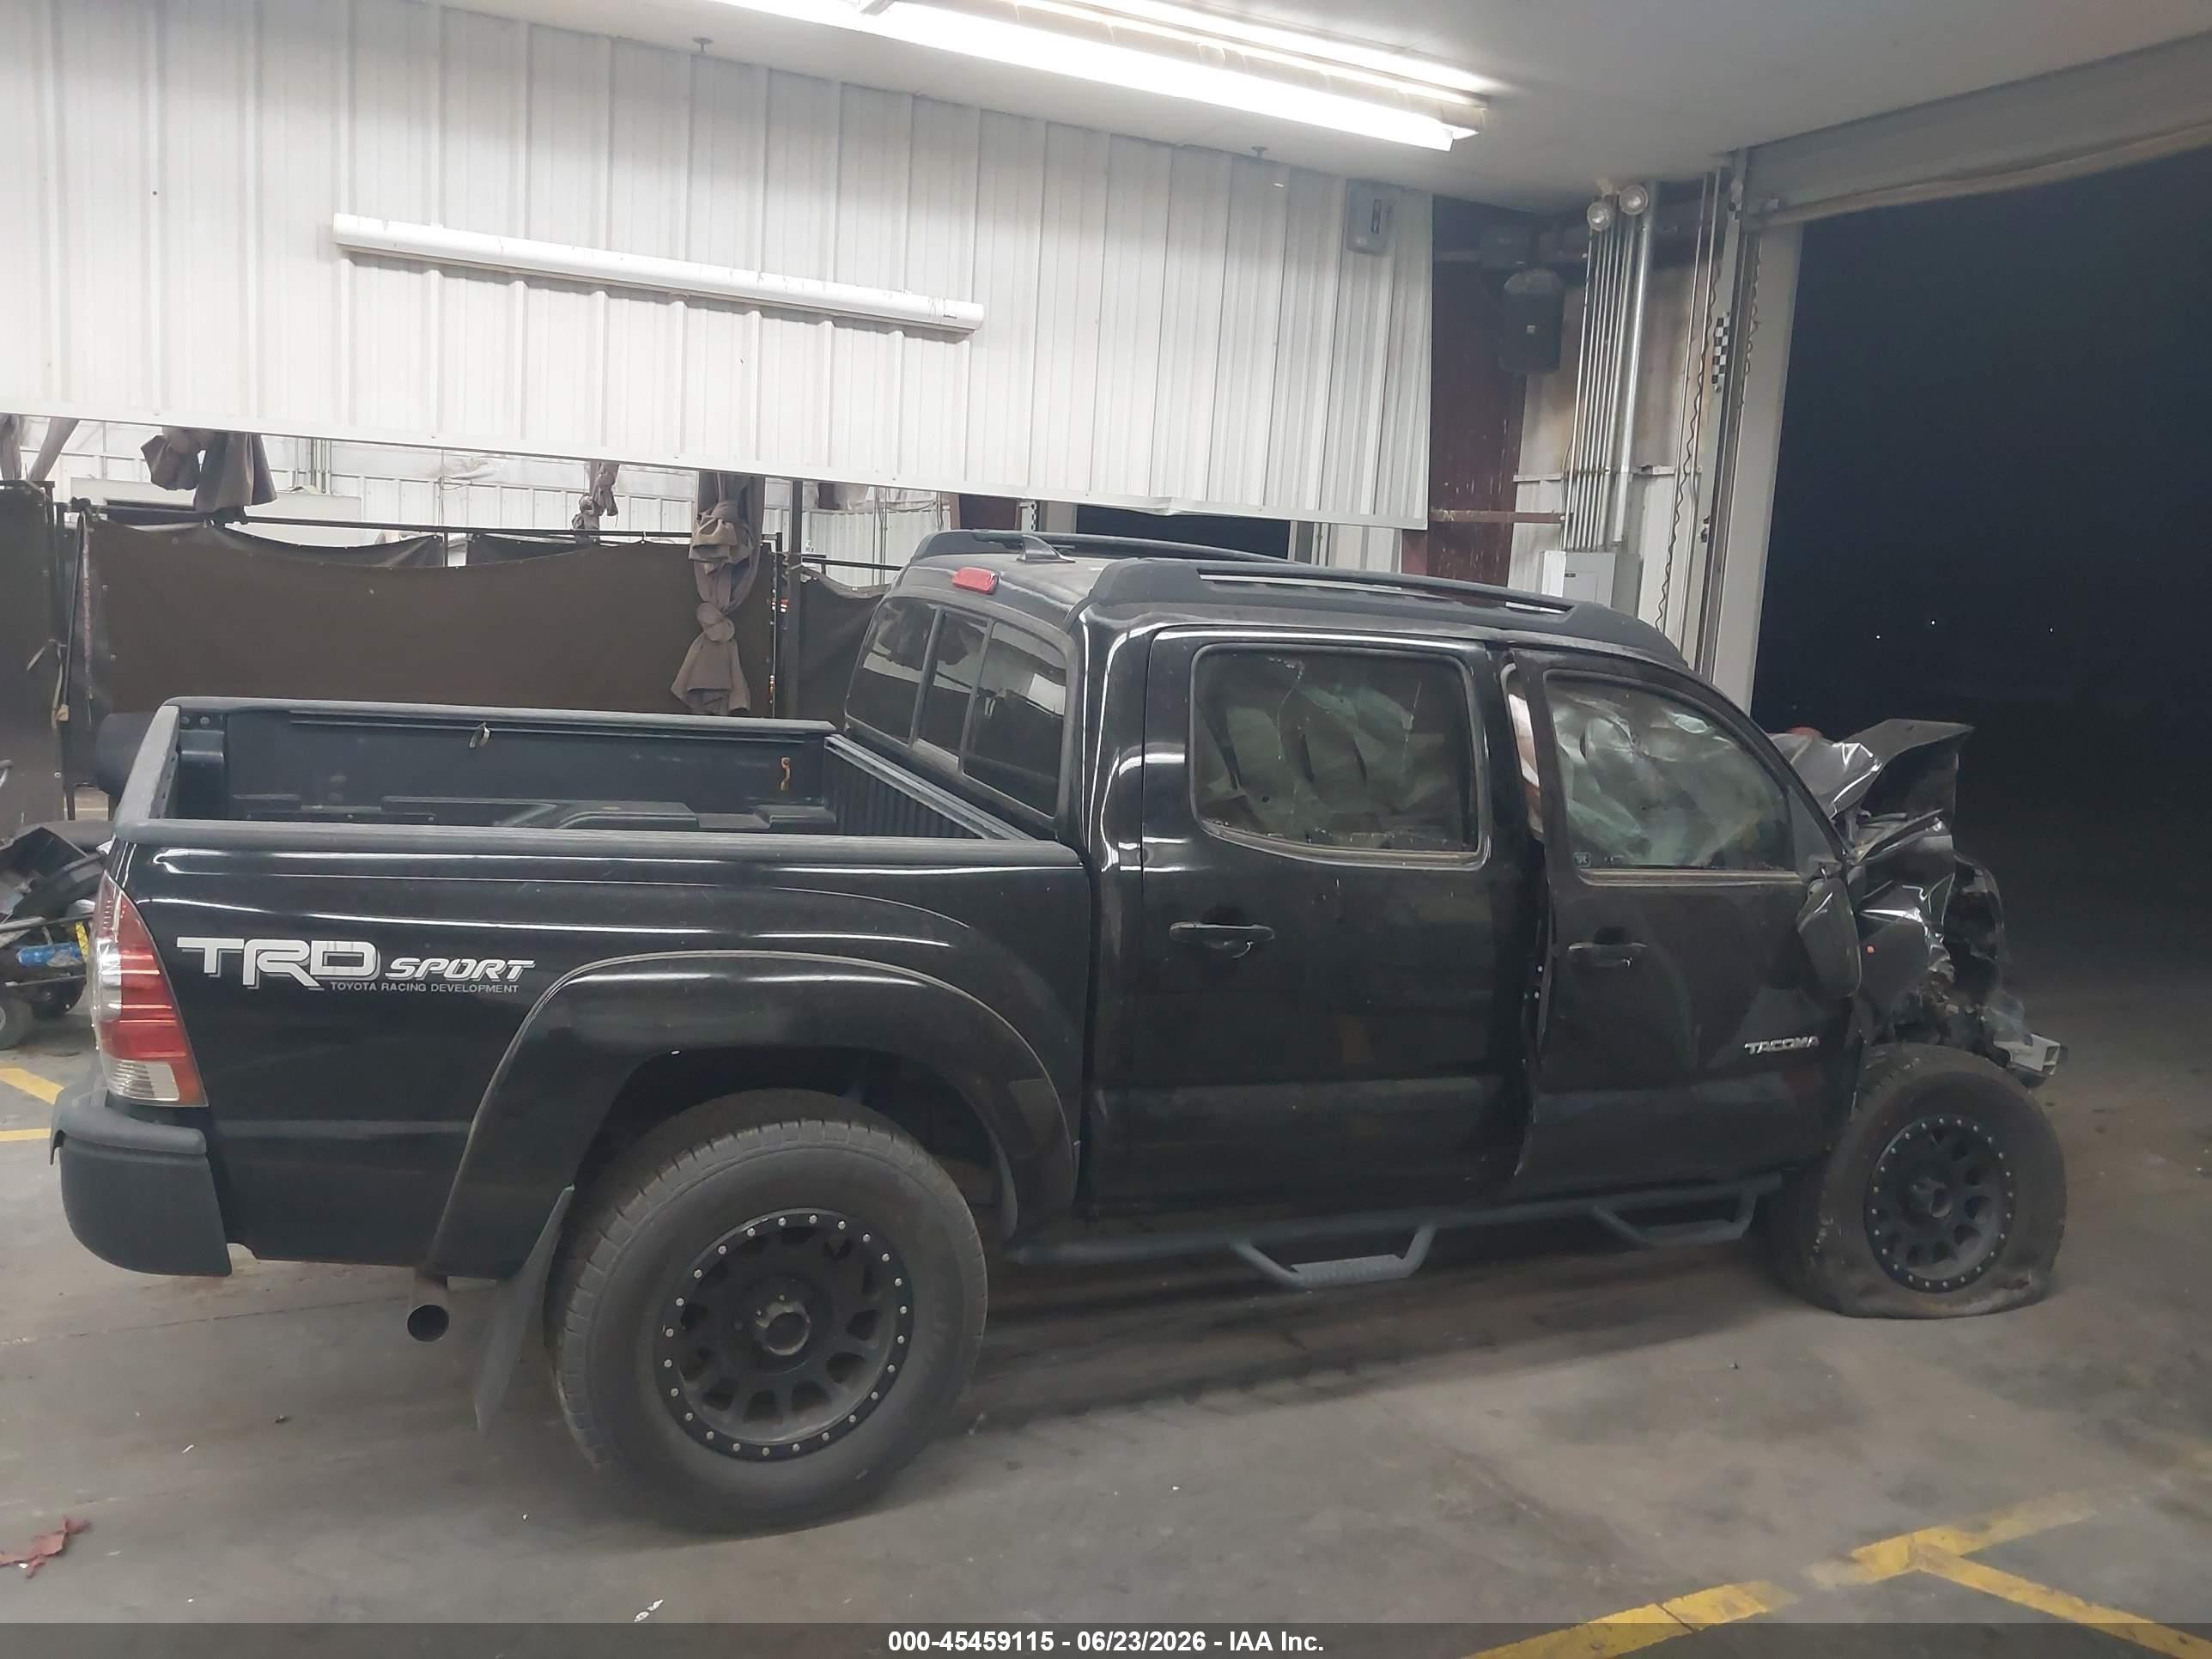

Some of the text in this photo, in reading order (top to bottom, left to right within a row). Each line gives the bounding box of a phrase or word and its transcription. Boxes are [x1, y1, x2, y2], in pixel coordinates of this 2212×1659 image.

[177, 937, 537, 991] TRD SPORT
[330, 981, 520, 994] TOYOTA RACING DEVELOPMENT
[1744, 1036, 1820, 1054] TACOMA
